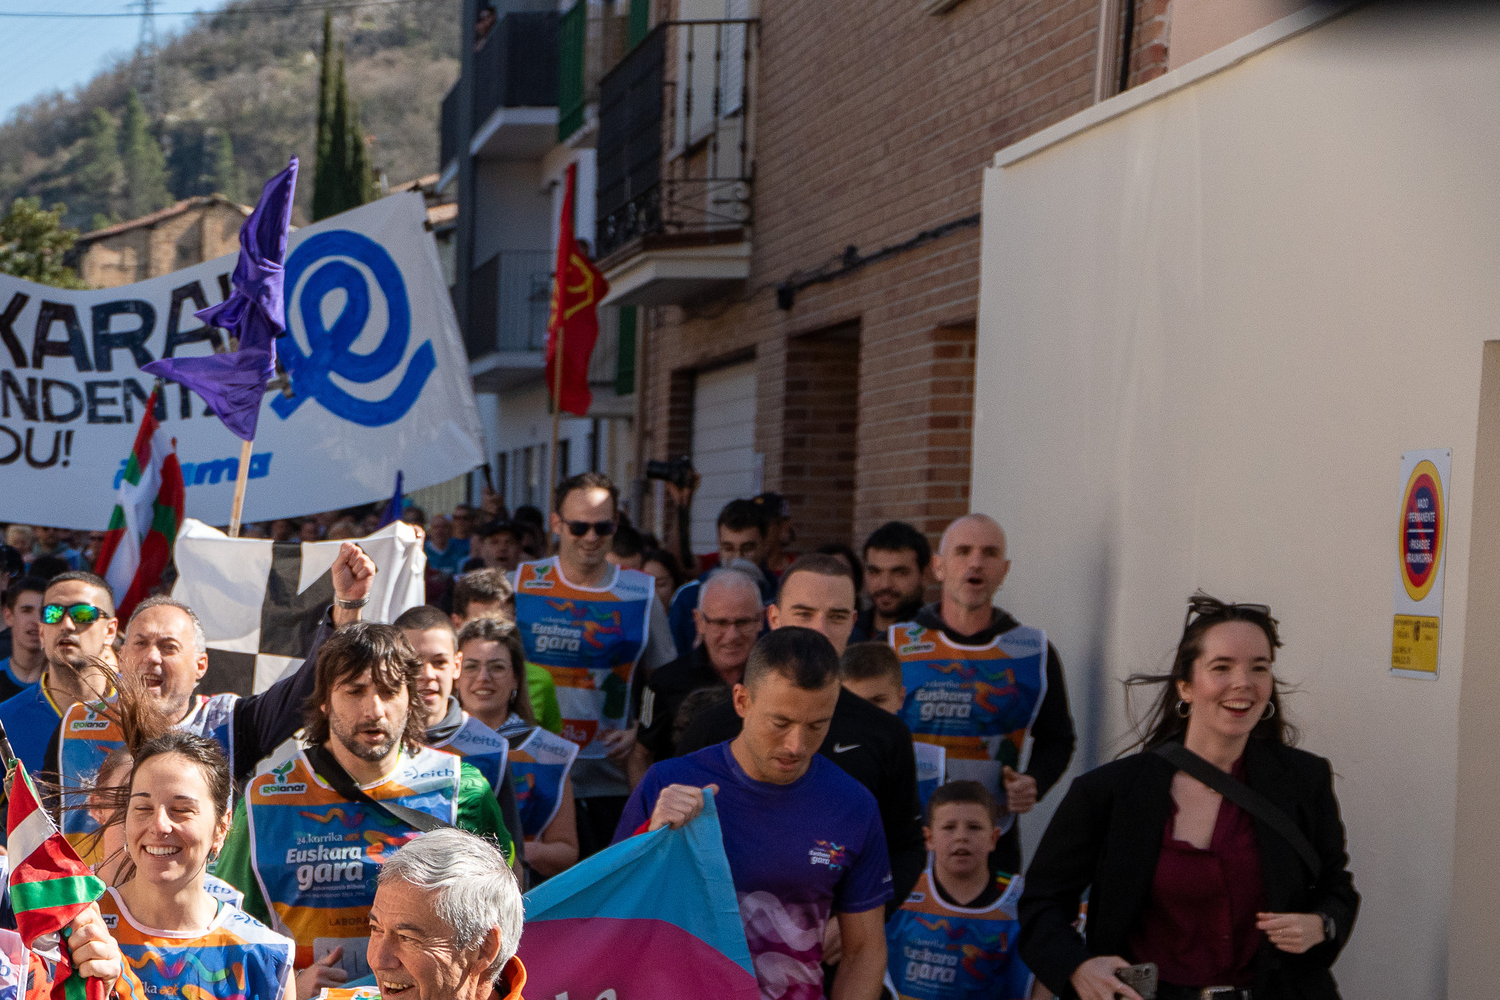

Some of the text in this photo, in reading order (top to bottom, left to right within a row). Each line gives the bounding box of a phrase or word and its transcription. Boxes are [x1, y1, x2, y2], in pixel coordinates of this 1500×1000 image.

[531, 622, 582, 639] Euskara
[535, 636, 581, 653] gara
[920, 701, 972, 721] gara
[472, 734, 502, 748] eitb
[418, 768, 455, 779] eitb
[297, 832, 343, 845] 24.korrika
[286, 844, 362, 864] Euskara
[296, 861, 363, 891] gara
[905, 962, 957, 984] gara
